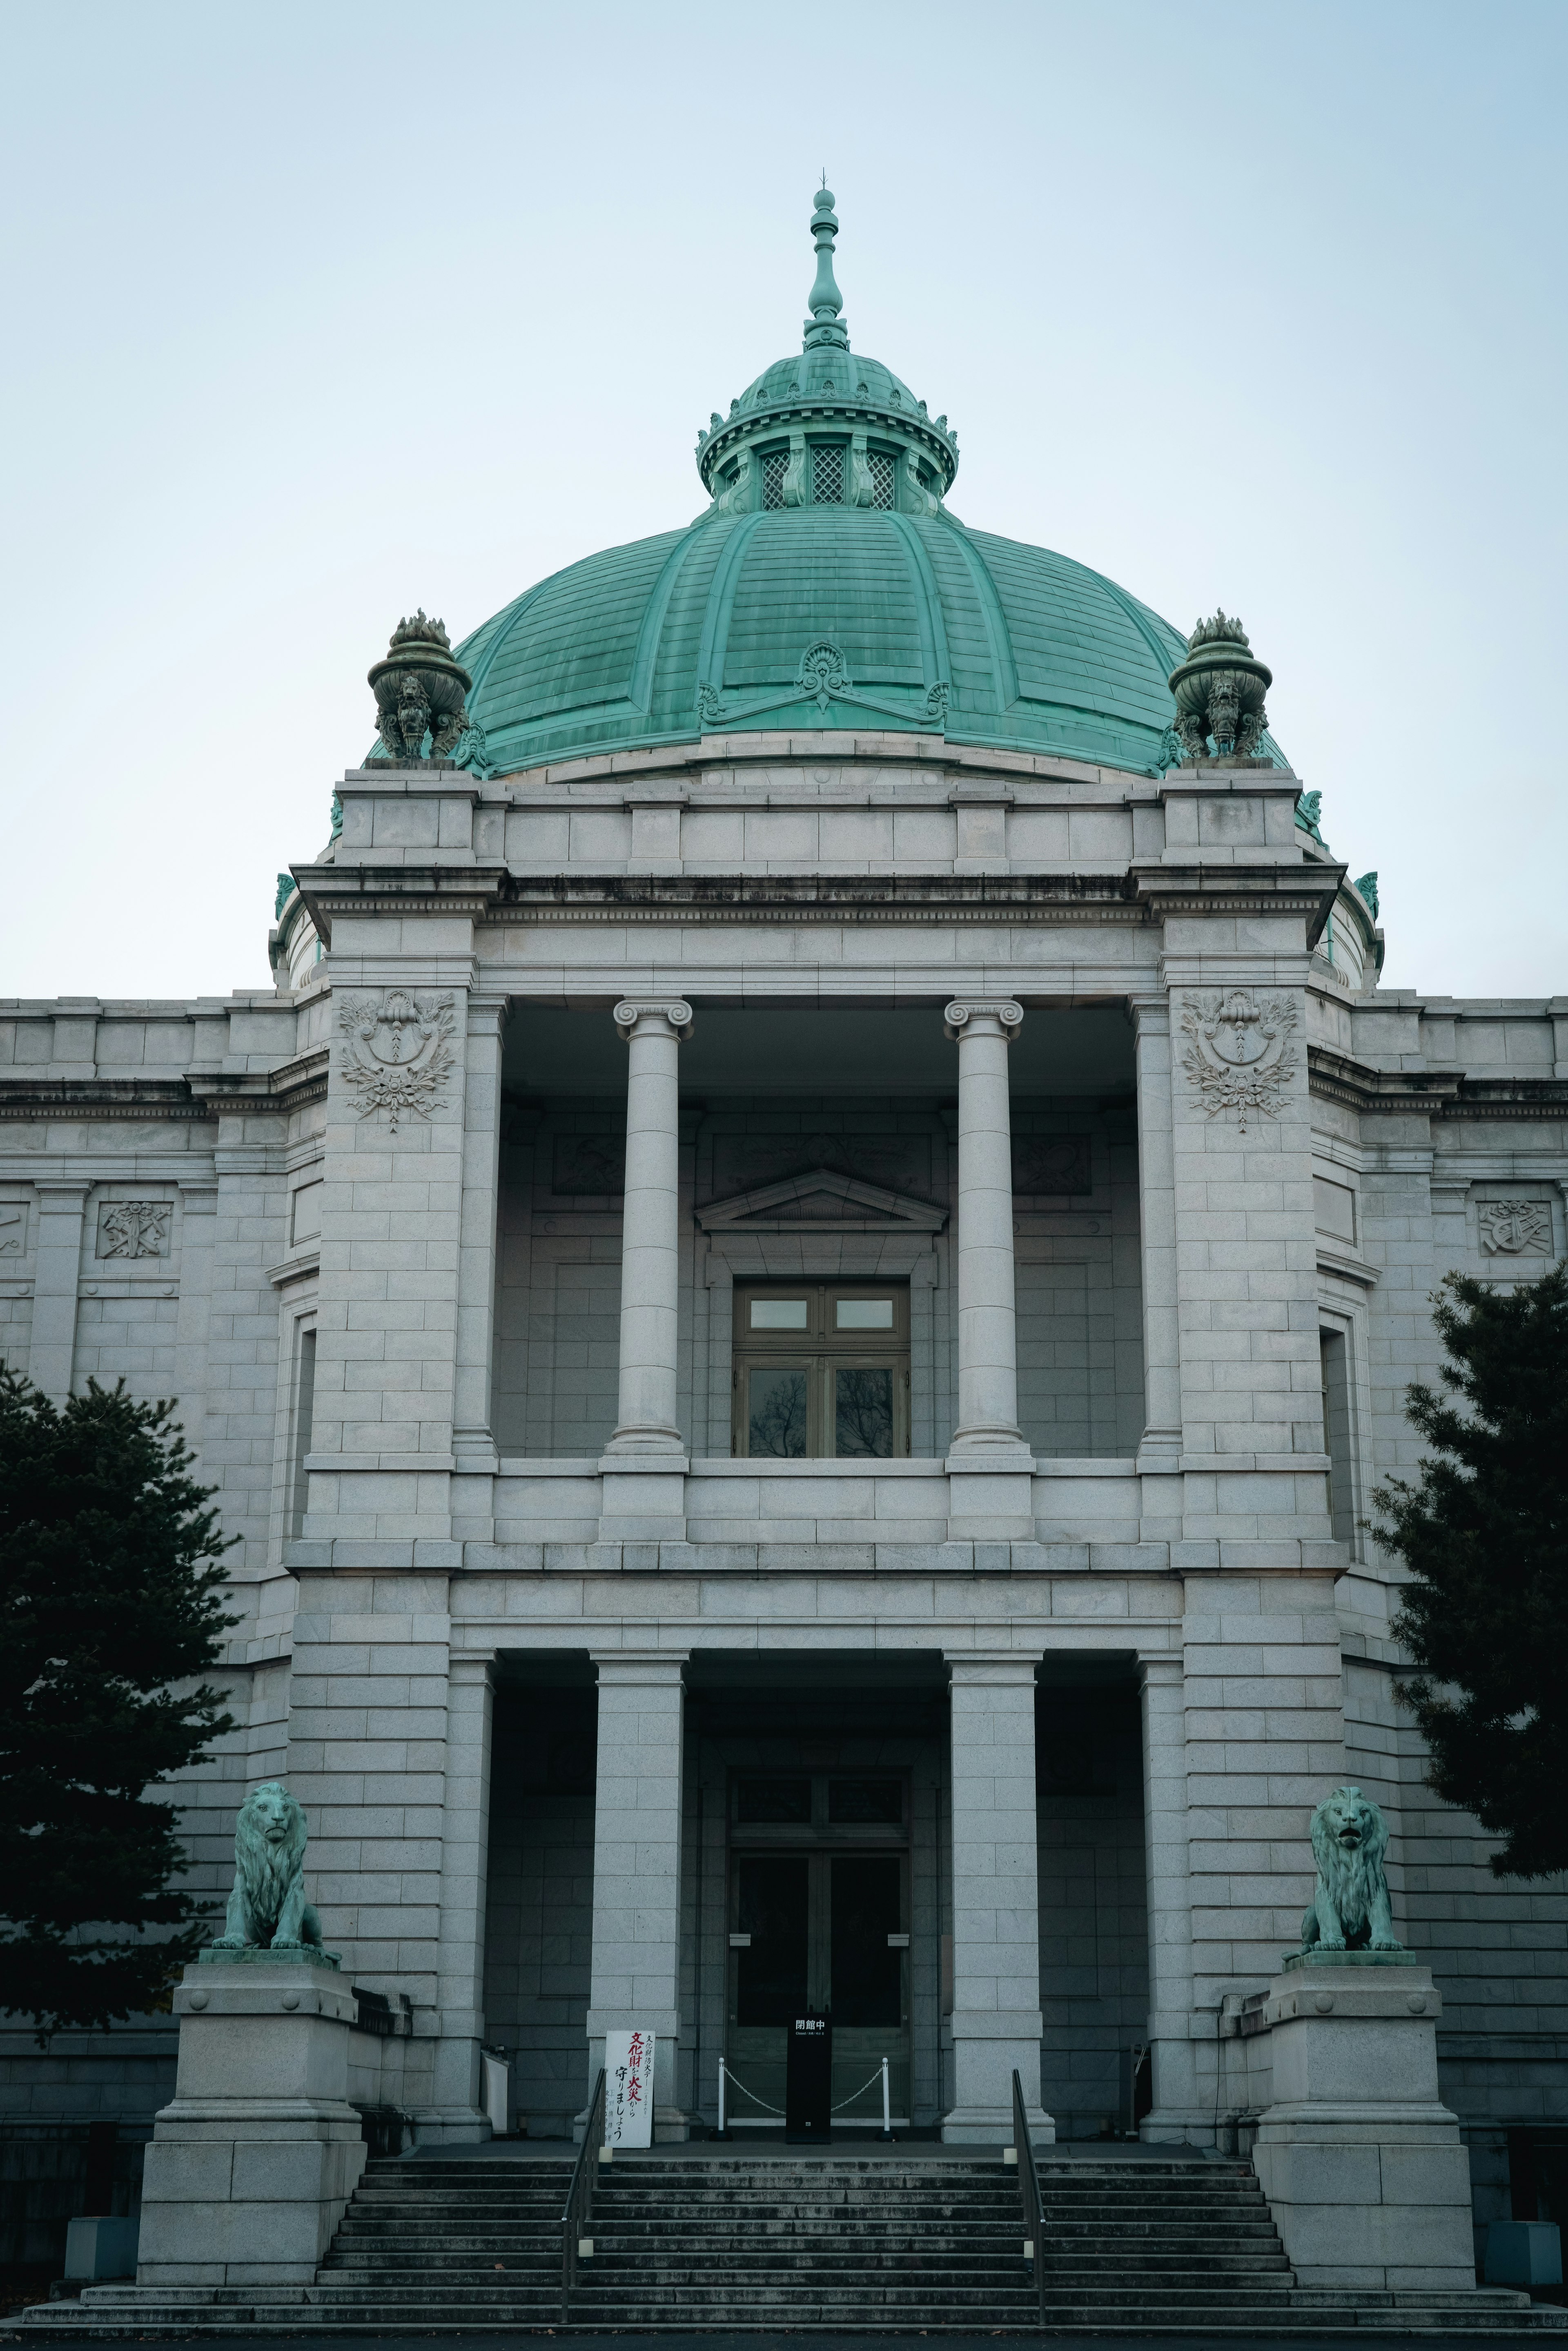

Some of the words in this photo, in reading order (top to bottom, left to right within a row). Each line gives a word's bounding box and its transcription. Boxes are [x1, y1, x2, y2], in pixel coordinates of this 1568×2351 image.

[796, 2020, 824, 2030] 閉館中
[614, 2066, 628, 2141] 守りましょう
[626, 2032, 645, 2117] 文化財を火災から
